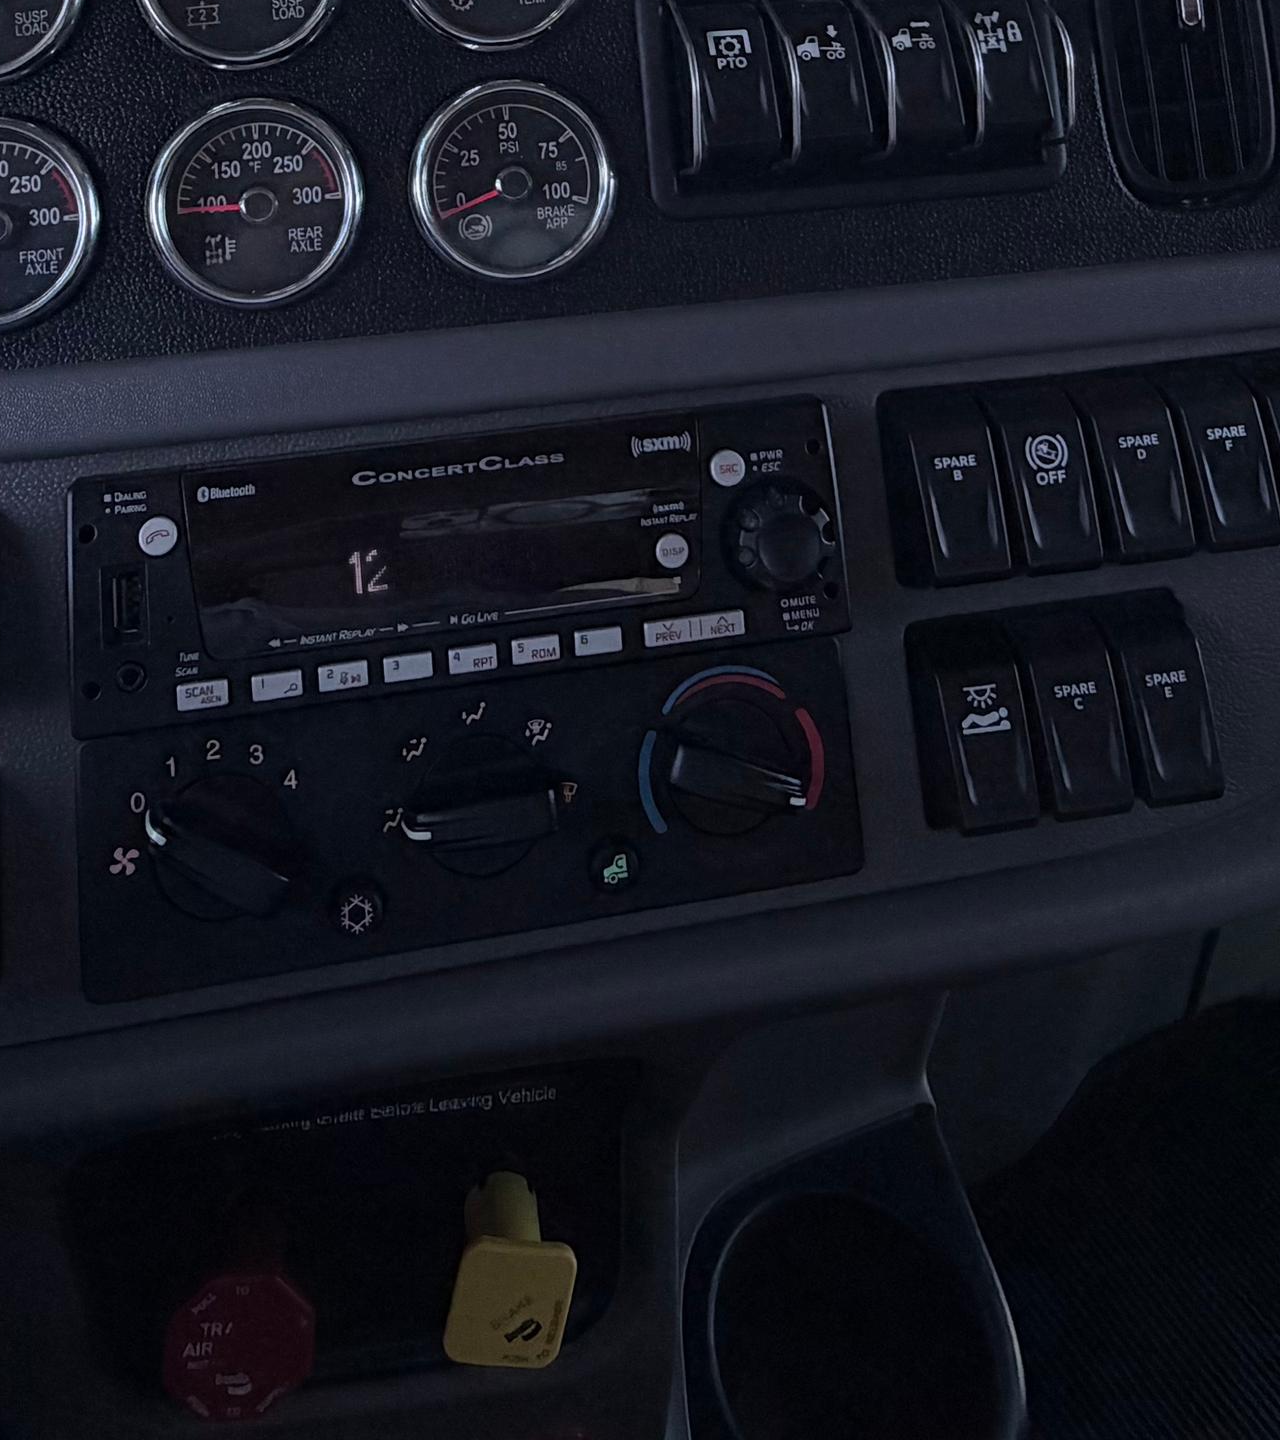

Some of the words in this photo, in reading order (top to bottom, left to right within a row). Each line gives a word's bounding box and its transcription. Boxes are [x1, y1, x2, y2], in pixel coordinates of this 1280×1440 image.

[14, 11, 49, 24] SUSP
[272, 6, 305, 20] LOAD
[15, 23, 50, 36] LOAD
[716, 56, 748, 71] PTO
[498, 122, 518, 139] 50
[241, 141, 272, 159] 200
[499, 140, 519, 153] PSI
[537, 142, 559, 159] 75
[273, 155, 304, 173] 250
[459, 149, 480, 166] 25
[210, 161, 240, 179] 150
[555, 160, 567, 171] 85
[9, 175, 42, 194] 250
[541, 183, 570, 200] 100
[292, 187, 322, 204] 300
[456, 191, 466, 208] 0
[28, 208, 61, 226] 300
[537, 205, 575, 220] BRAKE
[545, 216, 569, 229] APP
[288, 226, 323, 240] REAR
[289, 238, 322, 252] AXLE
[19, 248, 64, 263] FRONT
[24, 261, 59, 275] AXLE
[1206, 424, 1247, 441] SPARE
[641, 434, 681, 453] sxm
[1118, 433, 1160, 449] SPARE
[1225, 440, 1234, 452] F
[759, 449, 783, 461] PWR
[1136, 448, 1147, 461] D
[720, 462, 738, 474] SRC
[761, 461, 782, 472] ESC
[933, 454, 977, 470] SPARE
[953, 470, 963, 481] B
[1035, 470, 1067, 486] OFF
[209, 483, 256, 501] Bluetooth
[661, 546, 686, 557] DISP
[348, 548, 388, 595] 12
[790, 595, 816, 607] MUTE
[791, 608, 820, 620] MENU
[710, 622, 736, 634] NEXT
[800, 621, 815, 632] OK
[581, 635, 588, 644] 6
[655, 629, 682, 642] PREV
[518, 643, 524, 653] 5
[454, 652, 460, 661] 4
[473, 656, 494, 668] RPT
[392, 660, 400, 671] 3
[326, 669, 334, 679] 2
[1145, 670, 1187, 687] SPARE
[185, 685, 214, 699] SCAN
[1053, 682, 1097, 698] SPARE
[1164, 686, 1173, 699] E
[1073, 697, 1084, 710] C
[205, 739, 222, 761] 2
[248, 744, 264, 765] 3
[166, 757, 176, 778] 1
[283, 769, 298, 789] 4
[130, 792, 146, 813] 0
[497, 1086, 557, 1105] Vehicle
[181, 1341, 214, 1358] AIR
